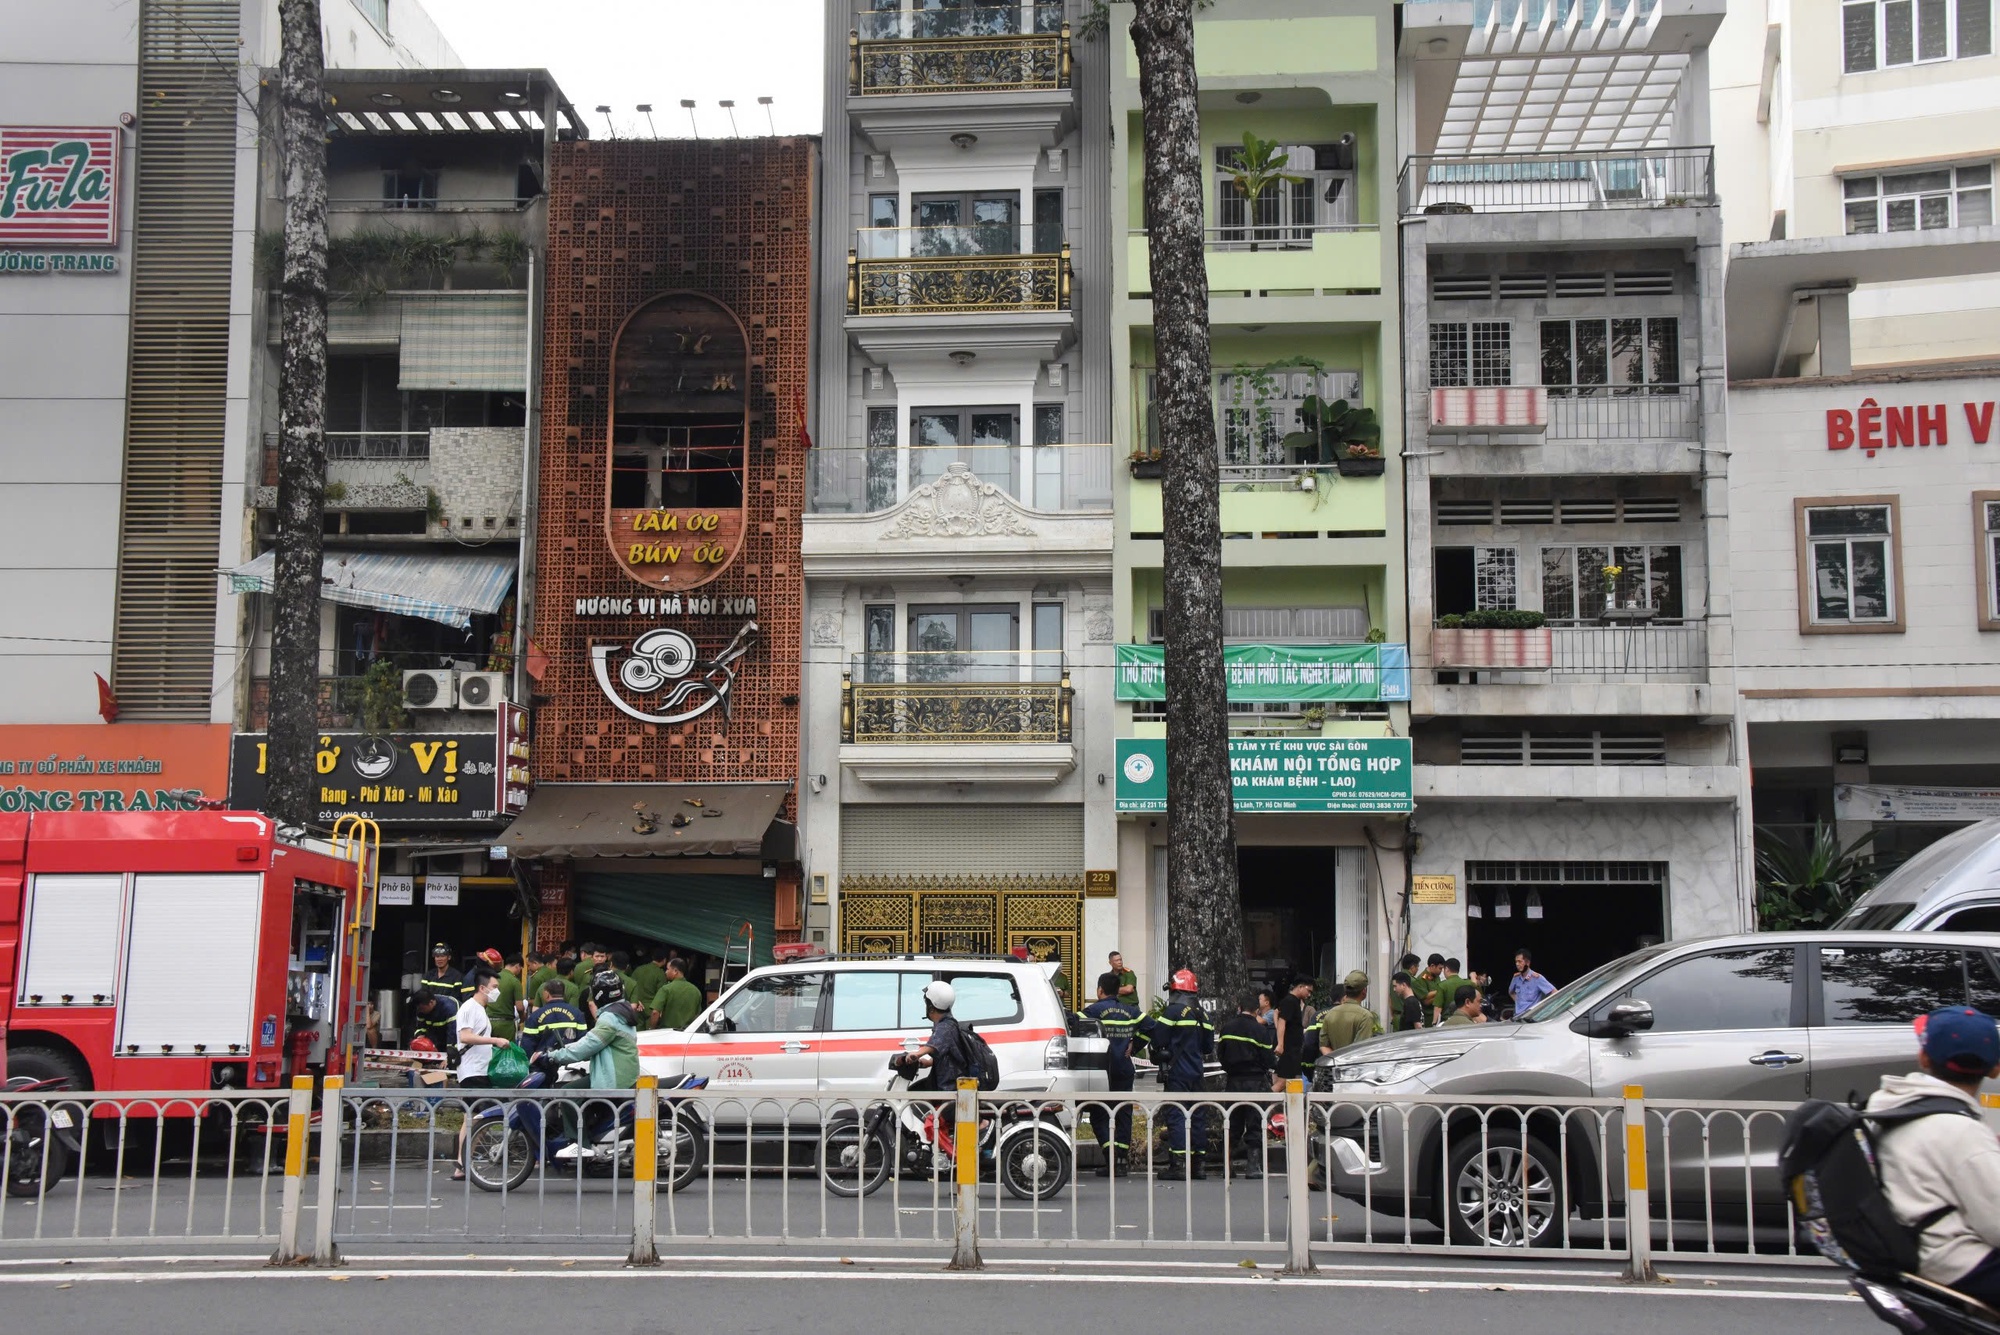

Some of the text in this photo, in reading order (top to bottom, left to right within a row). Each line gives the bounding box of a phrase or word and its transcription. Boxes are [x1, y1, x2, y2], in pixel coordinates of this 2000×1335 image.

[50, 255, 115, 270] TRANG
[1827, 398, 2000, 458] BỆNH V
[628, 538, 725, 565] BÚN ỐC
[575, 594, 757, 620] HƯƠNG VỊ HÀ NỘI XƯA
[1231, 657, 1256, 689] BỆNH
[1257, 651, 1279, 684] PHỔI
[1280, 653, 1299, 685] TẮC
[1332, 662, 1352, 689] MẠN
[1353, 657, 1375, 684] TÍNH
[1236, 741, 1258, 751] TÂM
[1260, 743, 1266, 751] Y
[1269, 740, 1281, 751] TẾ
[1283, 742, 1303, 751] KHU
[1306, 742, 1326, 753] VỰC
[1328, 741, 1345, 751] SÀI
[1347, 741, 1368, 751] GÒN
[18, 761, 34, 774] TY
[98, 761, 115, 774] XE
[117, 756, 161, 774] KHÁCH
[409, 740, 458, 783] Vị
[1230, 752, 1402, 774] KHÁM NỘI TỔNG HỢP
[1252, 775, 1285, 787] KHÁM
[1288, 775, 1318, 789] BỆNH
[1330, 776, 1356, 789] LAO)
[321, 787, 347, 805] Rang
[360, 785, 380, 802] Phở
[384, 786, 405, 802] Xào
[418, 787, 432, 802] Mì
[437, 786, 458, 803] Xào
[1092, 873, 1110, 882] 229
[1414, 880, 1430, 890] TIẾN
[381, 882, 411, 892] Phở Bò
[426, 882, 457, 892] Phở Xào
[542, 888, 564, 900] 227
[727, 1069, 743, 1078] 114
